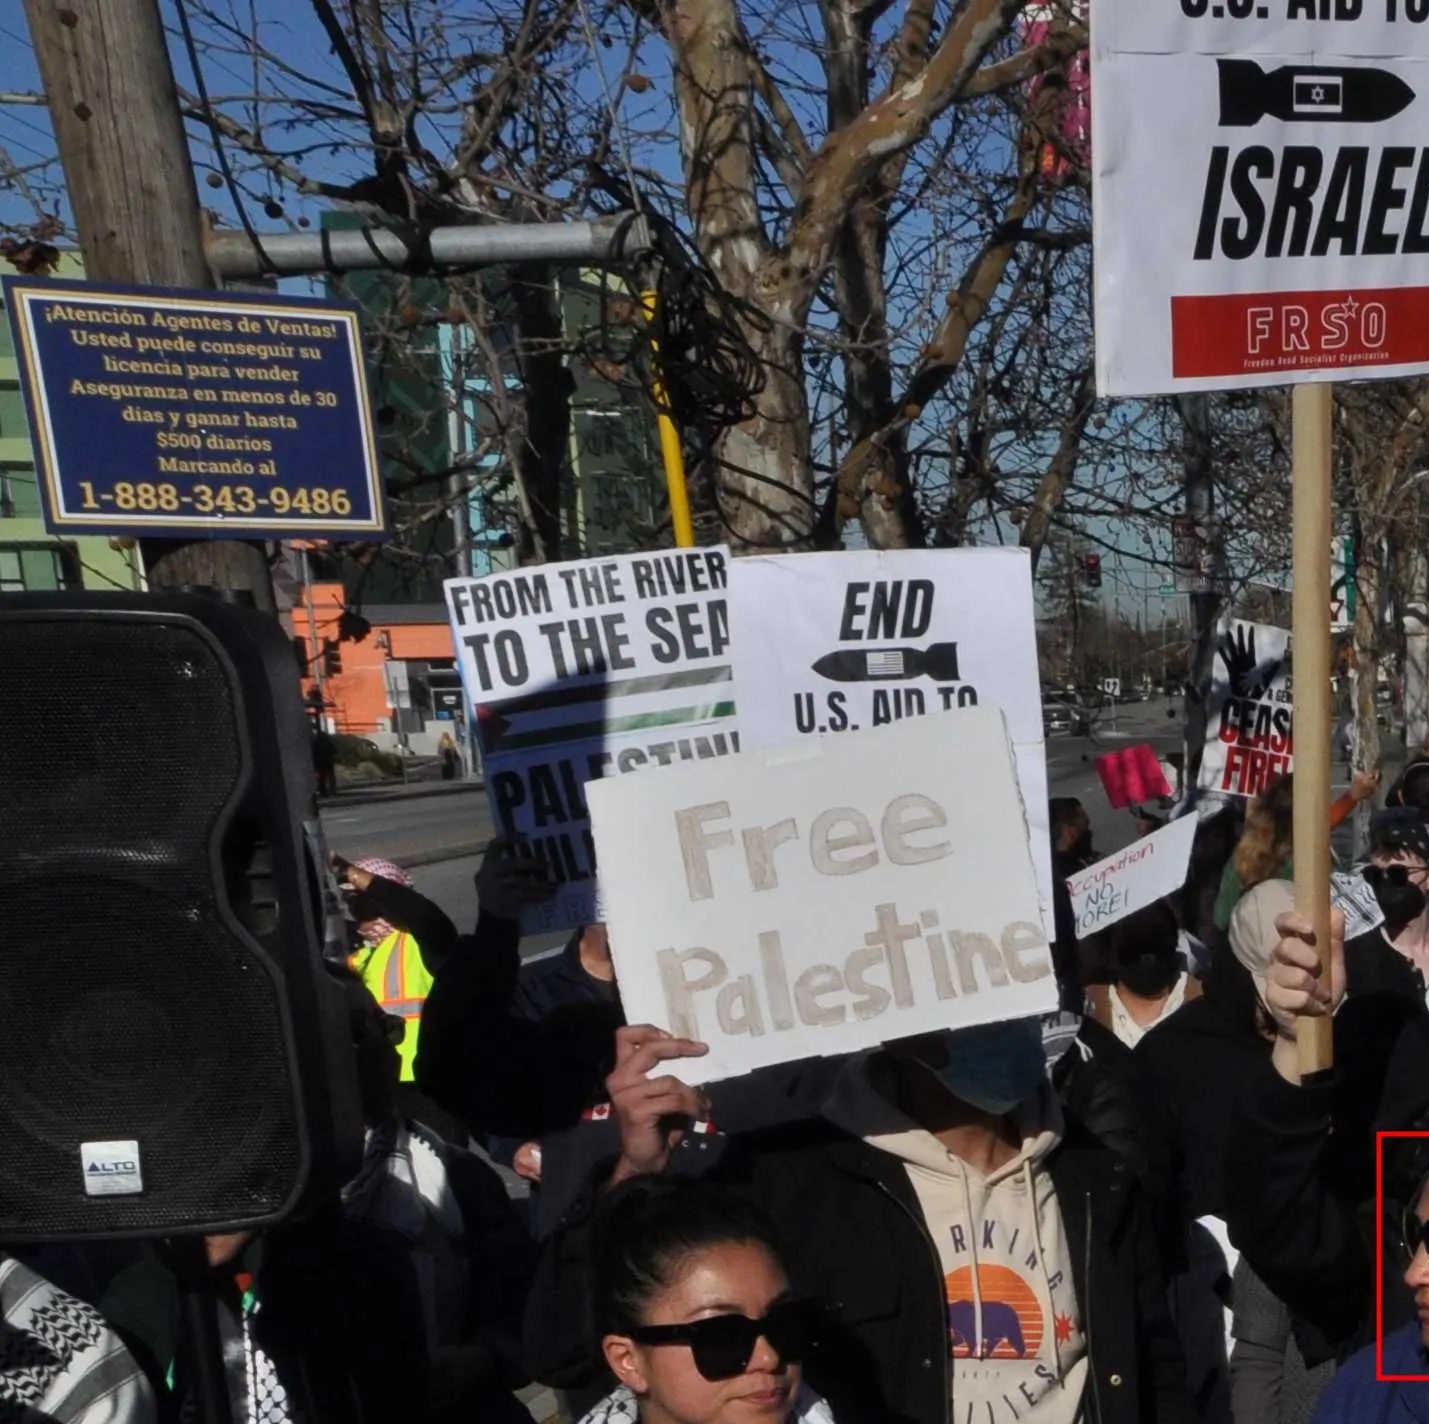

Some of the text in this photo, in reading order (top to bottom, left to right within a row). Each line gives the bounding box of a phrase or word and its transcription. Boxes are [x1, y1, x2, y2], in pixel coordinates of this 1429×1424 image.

[46, 304, 337, 338] ¡Atención Agentes de Ventas!
[1247, 302, 1387, 354] FRSO
[71, 329, 322, 361] Usted puede conseguir su
[104, 355, 300, 382] licencia para vender
[70, 379, 337, 407] Aseguranza en menos de 30
[169, 412, 180, 427] y
[187, 412, 240, 429] ganar
[245, 411, 298, 428] hasta
[156, 433, 273, 452] $500 diarios
[159, 456, 277, 476] Marcando al
[79, 481, 352, 515] 1-888-343-9486
[450, 550, 727, 627] FROM THE RIVER
[839, 578, 936, 641] END
[464, 598, 730, 692] TO THE SEA
[794, 690, 860, 734] U.S.
[872, 687, 926, 727] AID
[1218, 698, 1293, 756] CEAS
[675, 792, 954, 902] Free
[1085, 882, 1114, 909] NO
[656, 903, 1053, 1043] Palestine
[87, 1161, 136, 1172] ALTO
